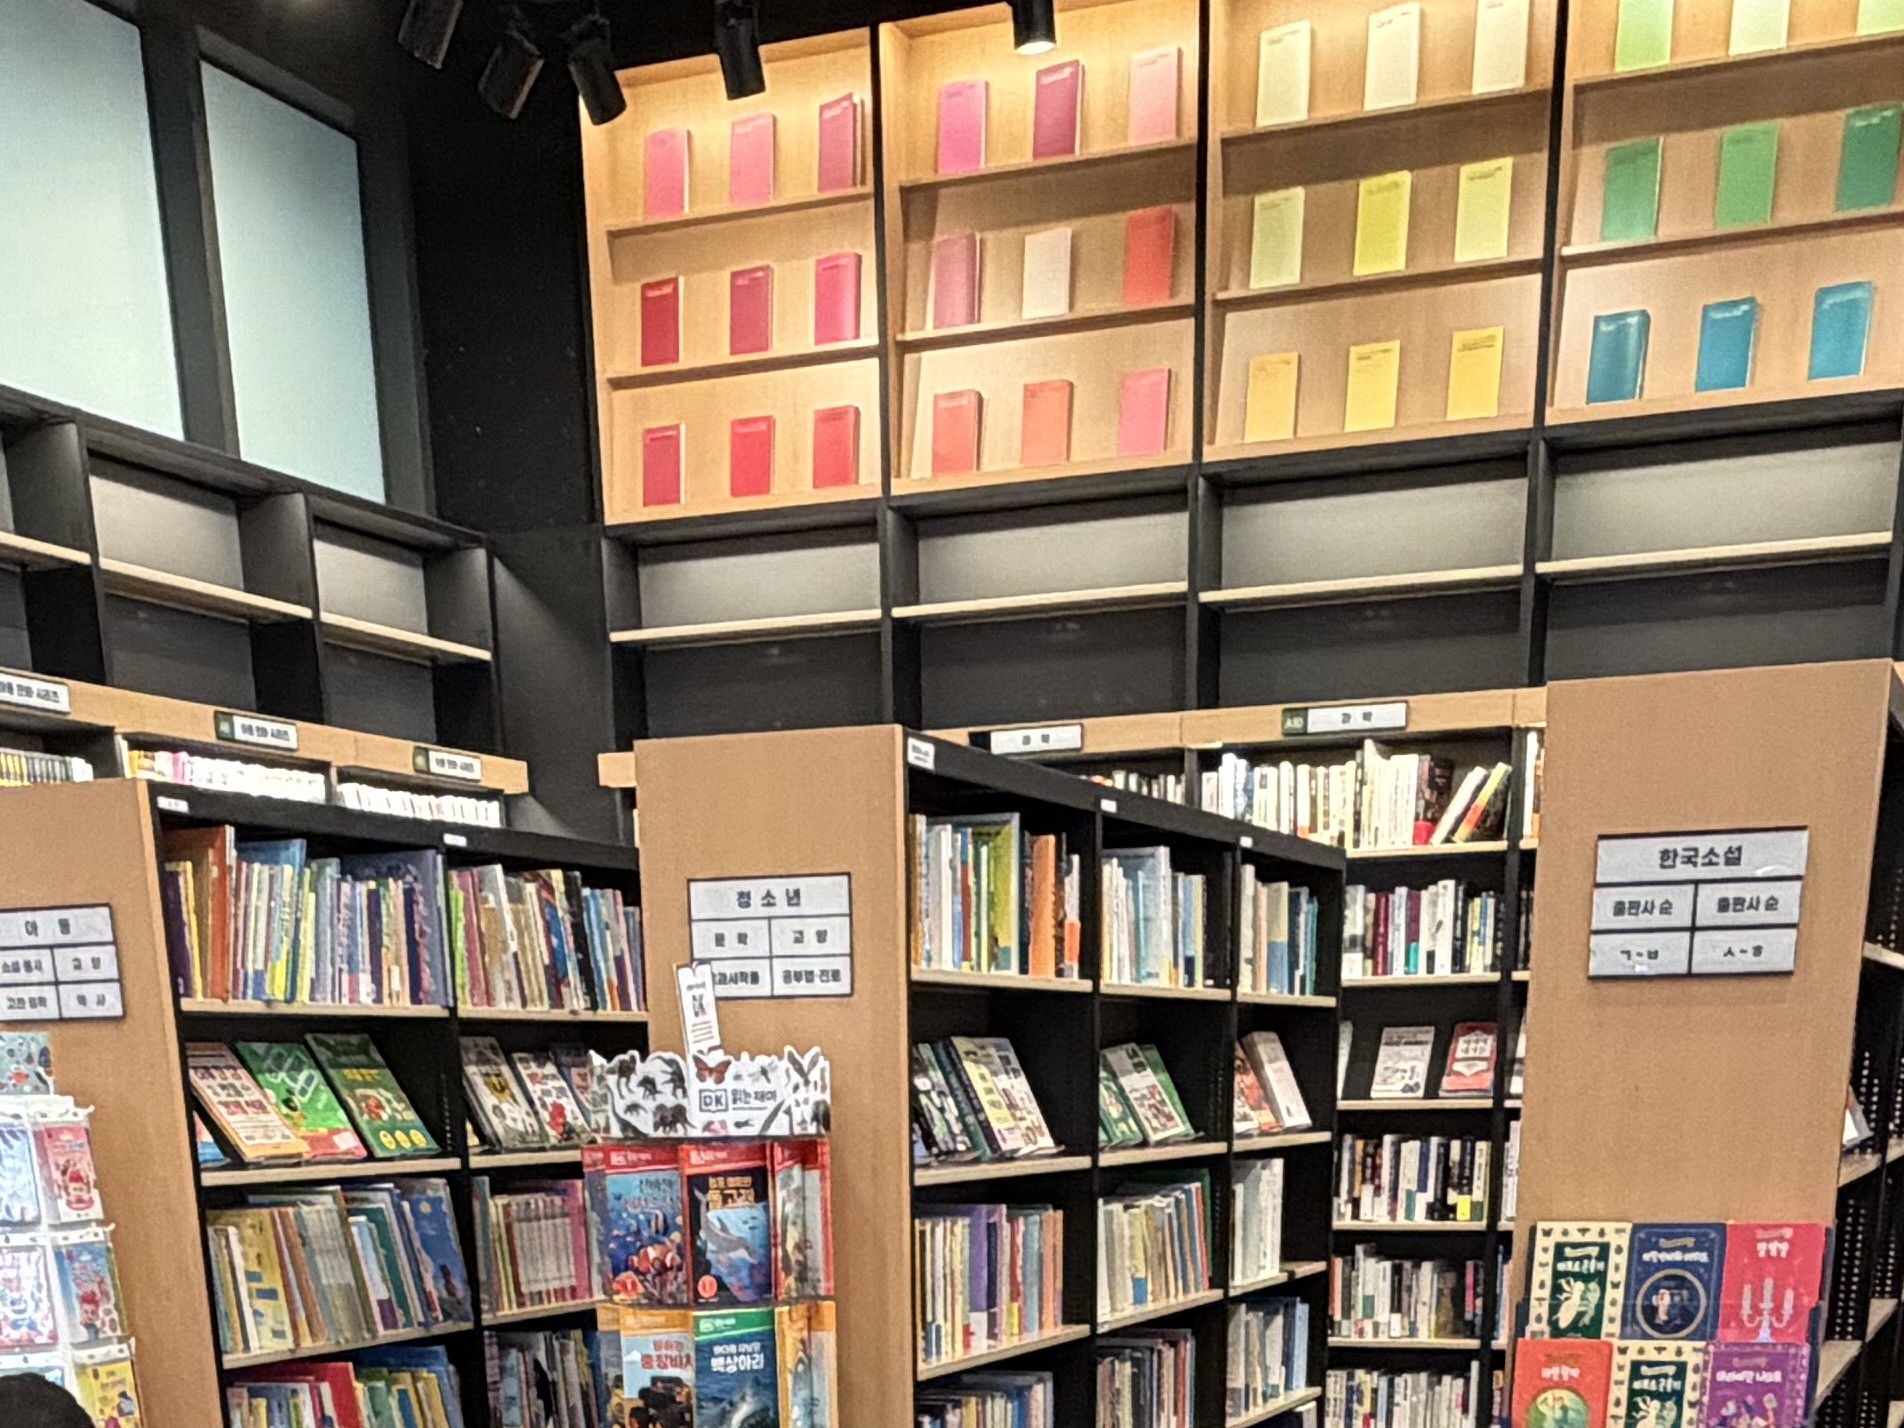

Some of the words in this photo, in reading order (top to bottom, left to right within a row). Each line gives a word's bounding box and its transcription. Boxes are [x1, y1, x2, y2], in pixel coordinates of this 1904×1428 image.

[1659, 845, 1743, 869] 한국소설
[1613, 900, 1656, 917] 출판사
[1659, 899, 1674, 915] 순
[1717, 896, 1761, 913] 출판사
[1764, 895, 1780, 911] 순
